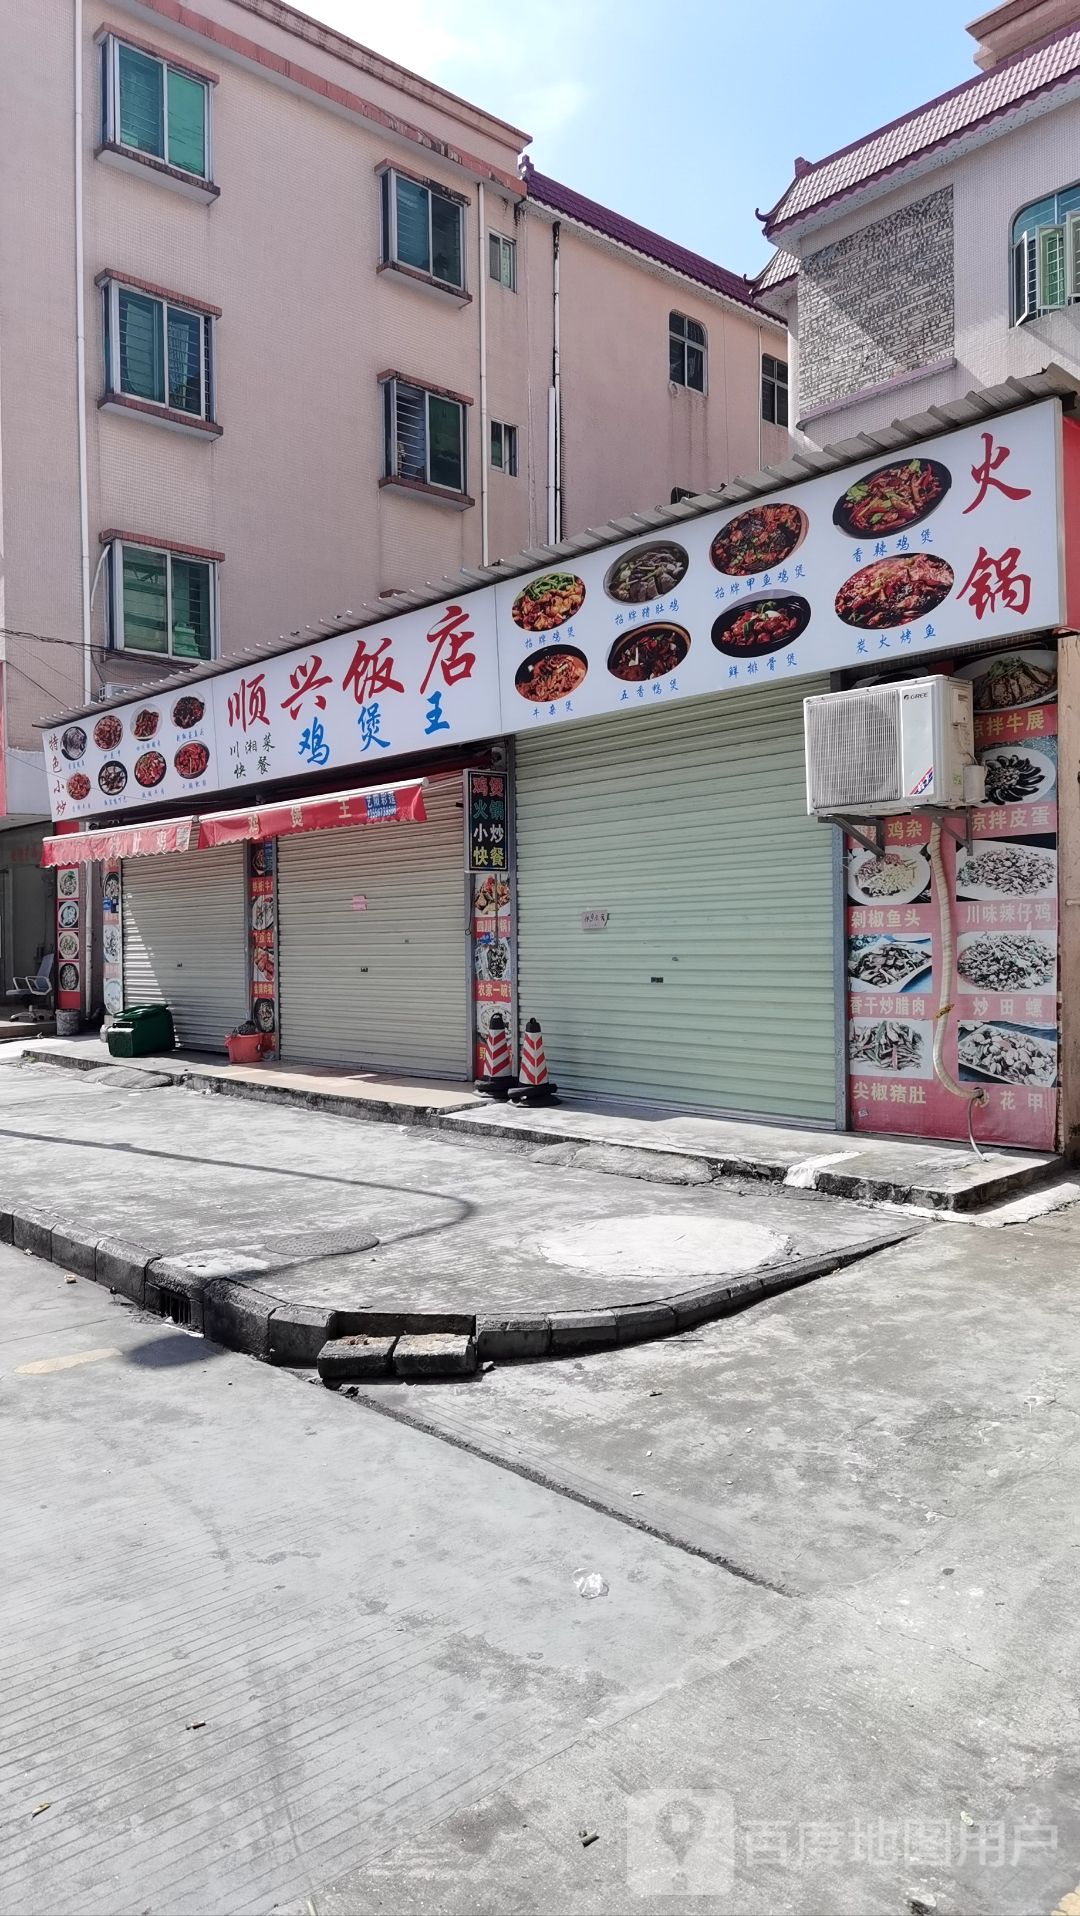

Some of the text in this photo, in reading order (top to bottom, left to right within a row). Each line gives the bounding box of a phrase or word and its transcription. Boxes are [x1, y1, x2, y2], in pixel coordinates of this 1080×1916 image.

[957, 432, 1032, 622] 火锅
[852, 528, 934, 563] 香辣鸡煲
[714, 563, 807, 600] 招牌甲鱼鸡煲
[614, 599, 681, 626] 招牌猪肚鸡
[524, 626, 576, 648] 招牌鸡煲
[856, 623, 937, 655] 炭火烤鱼
[227, 605, 477, 732] 顺兴饭店
[728, 652, 798, 679] 鲜排骨煲
[620, 679, 679, 701] 五香鸭煲
[532, 700, 574, 719] 牛杂煲
[298, 690, 451, 765] 鸡煲王
[230, 731, 276, 758] 川湘菜
[49, 733, 67, 816] 特色小炒
[233, 755, 272, 779] 快餐
[473, 776, 505, 798] 鸡煲
[473, 799, 505, 821] 火锅
[473, 822, 505, 844] 小炒
[473, 846, 505, 868] 快餐
[252, 879, 273, 893] 铁板牛
[851, 908, 921, 929] 剁椒鱼头
[966, 902, 1050, 924] 川味辣仔鸡
[850, 996, 925, 1016] 香干炒腊肉
[973, 997, 1043, 1017] 炒田螺
[853, 1082, 927, 1105] 尖椒猪肚
